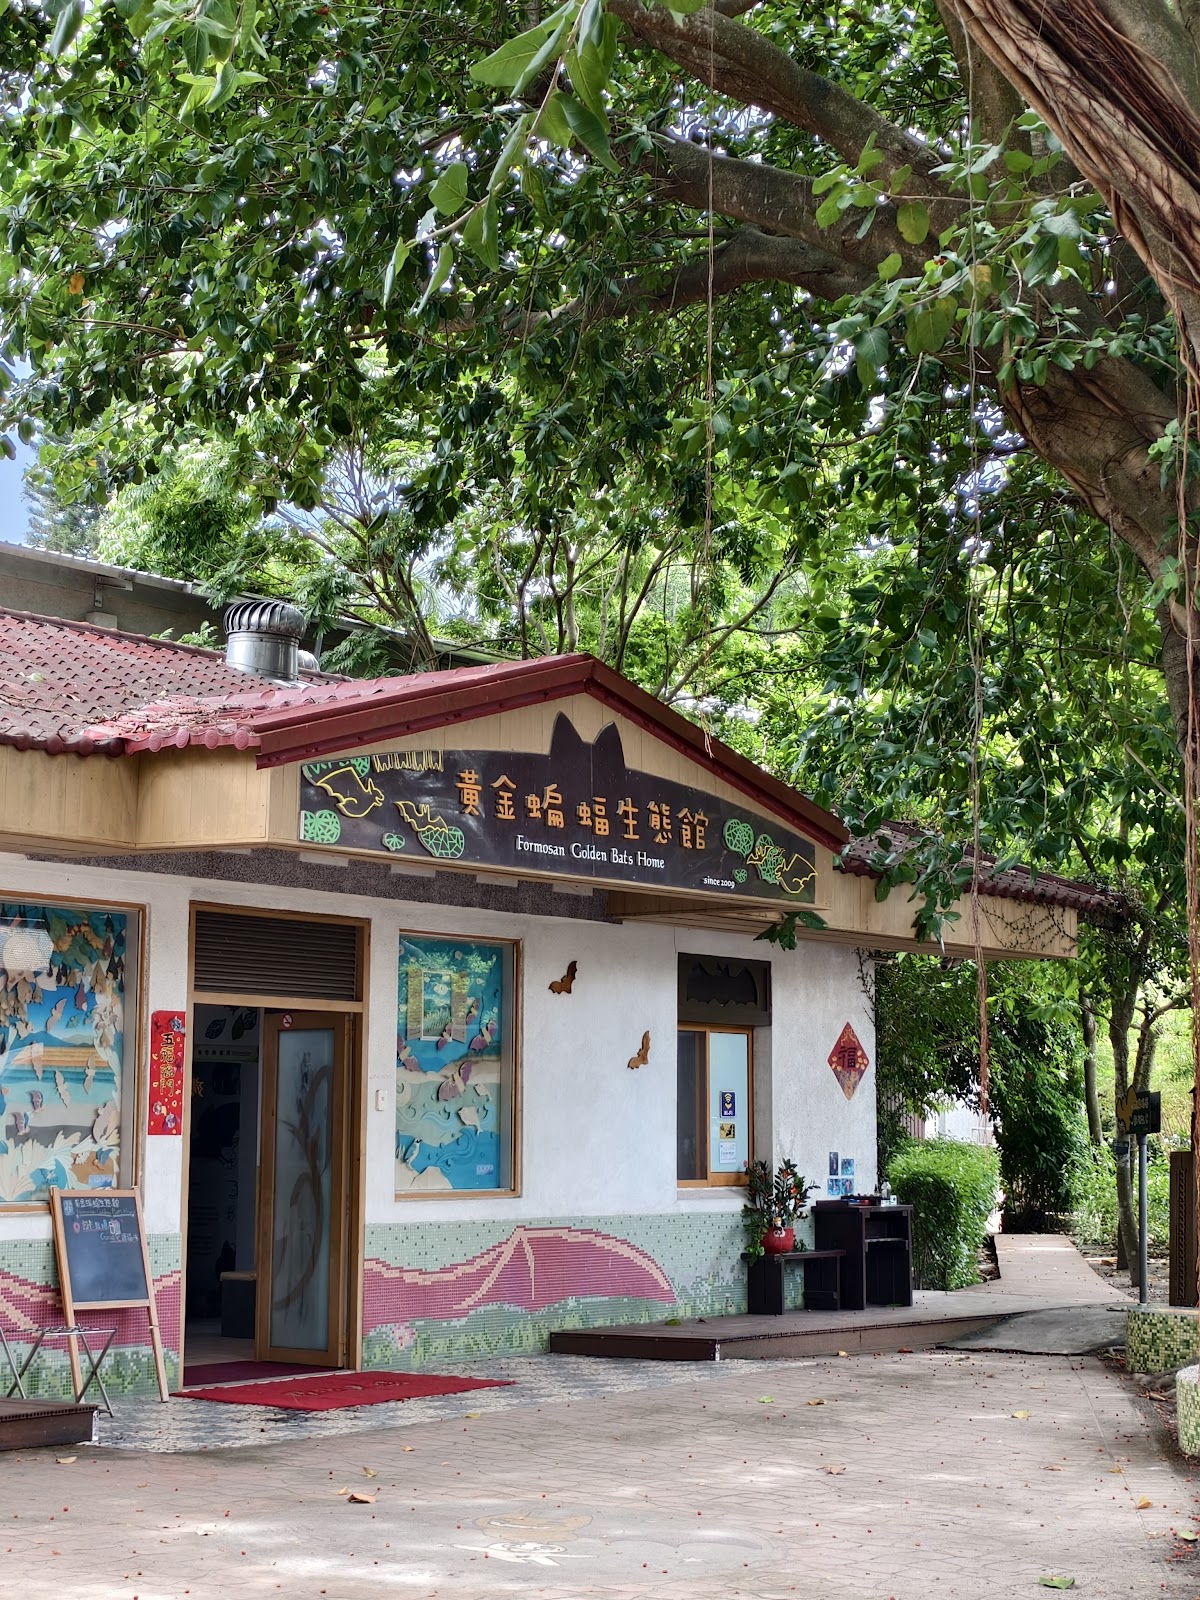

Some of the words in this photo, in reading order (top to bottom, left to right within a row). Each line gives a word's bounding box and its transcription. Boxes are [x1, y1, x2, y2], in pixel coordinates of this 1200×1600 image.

[455, 769, 709, 850] 黃金蝙蝠生態館
[517, 835, 565, 856] Formosan
[572, 843, 607, 862] Golden
[612, 848, 634, 865] Bats
[638, 852, 665, 869] Home
[703, 875, 720, 886] since
[721, 879, 736, 889] 2009
[838, 1046, 857, 1069] 福
